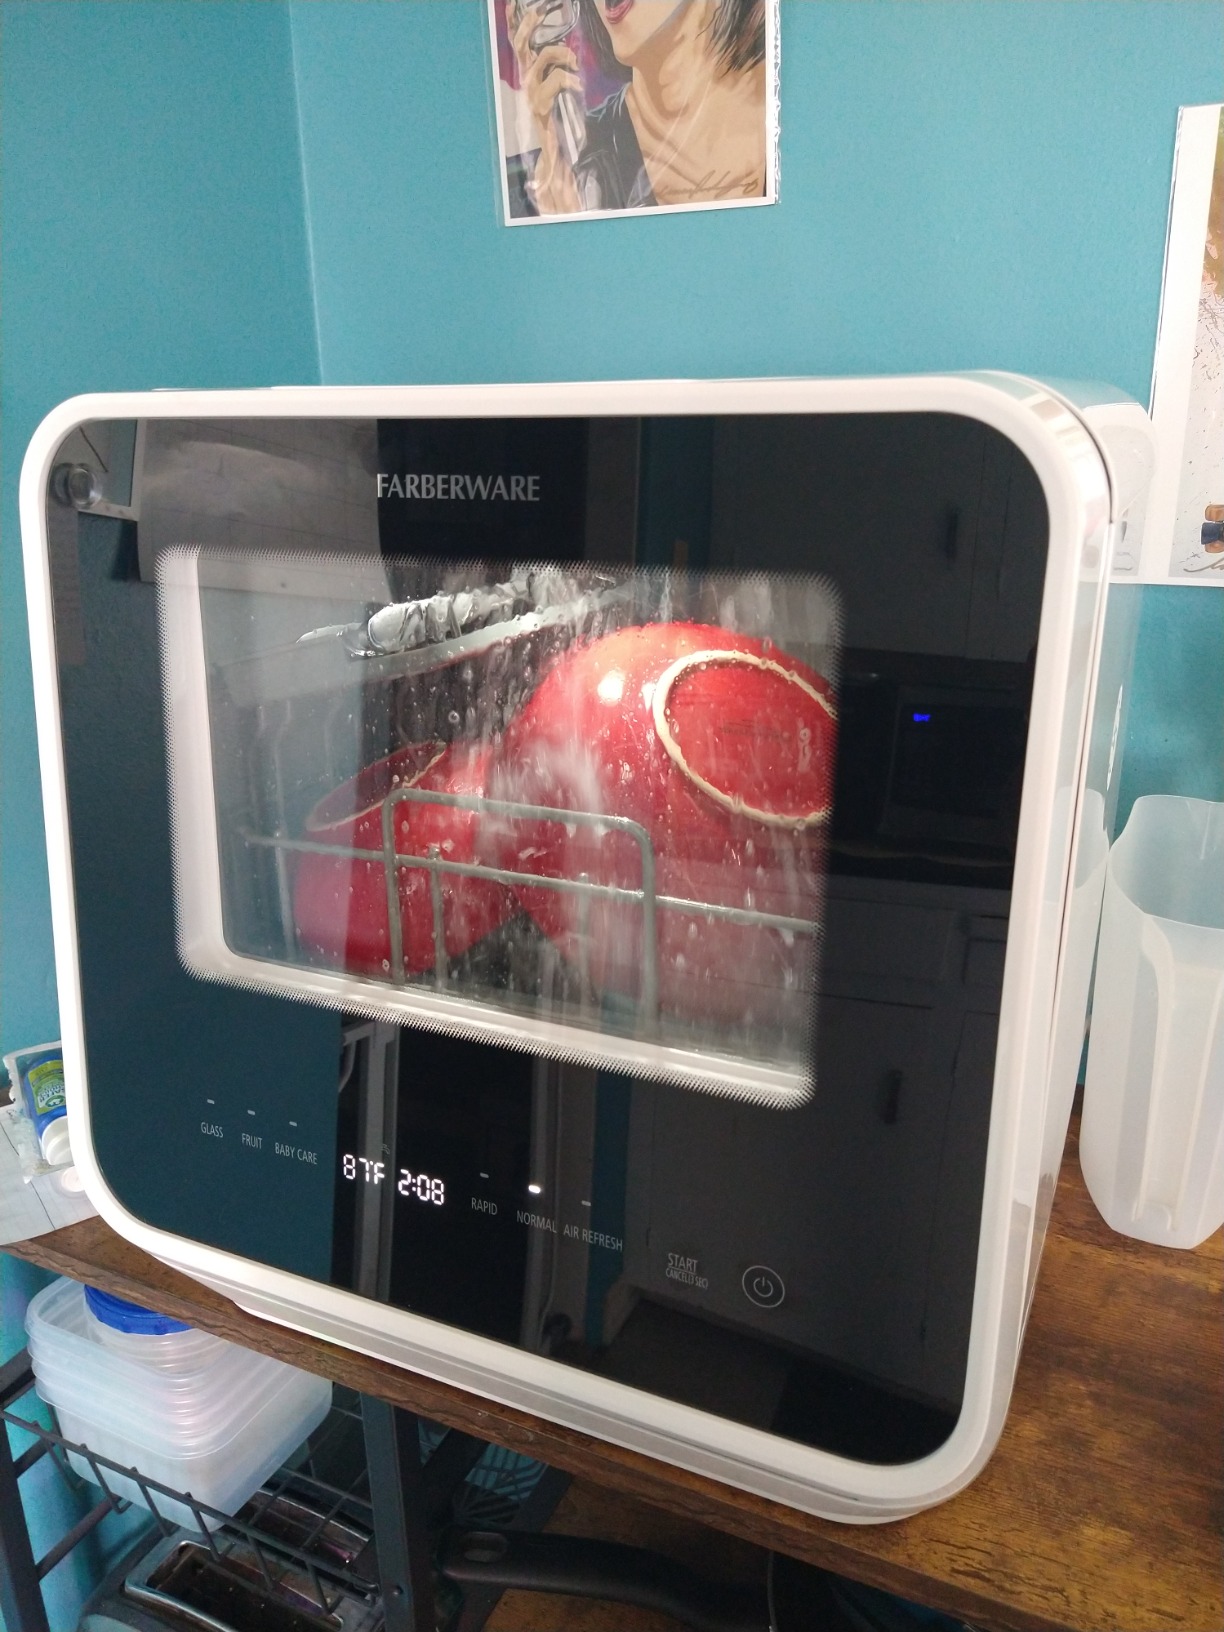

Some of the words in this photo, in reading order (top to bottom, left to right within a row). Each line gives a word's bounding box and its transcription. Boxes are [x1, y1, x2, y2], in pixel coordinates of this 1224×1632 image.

[376, 473, 541, 501] FARBERWARE
[200, 1121, 224, 1139] GLASS
[241, 1132, 263, 1149] FRUIT
[274, 1142, 295, 1158] BABY
[297, 1148, 318, 1165] CARE
[397, 1168, 445, 1206] 2:08
[471, 1197, 498, 1216] RAPID
[516, 1209, 558, 1234] NORMAL
[563, 1223, 580, 1239] AIR
[582, 1228, 624, 1252] REFRESH
[667, 1252, 698, 1273] START
